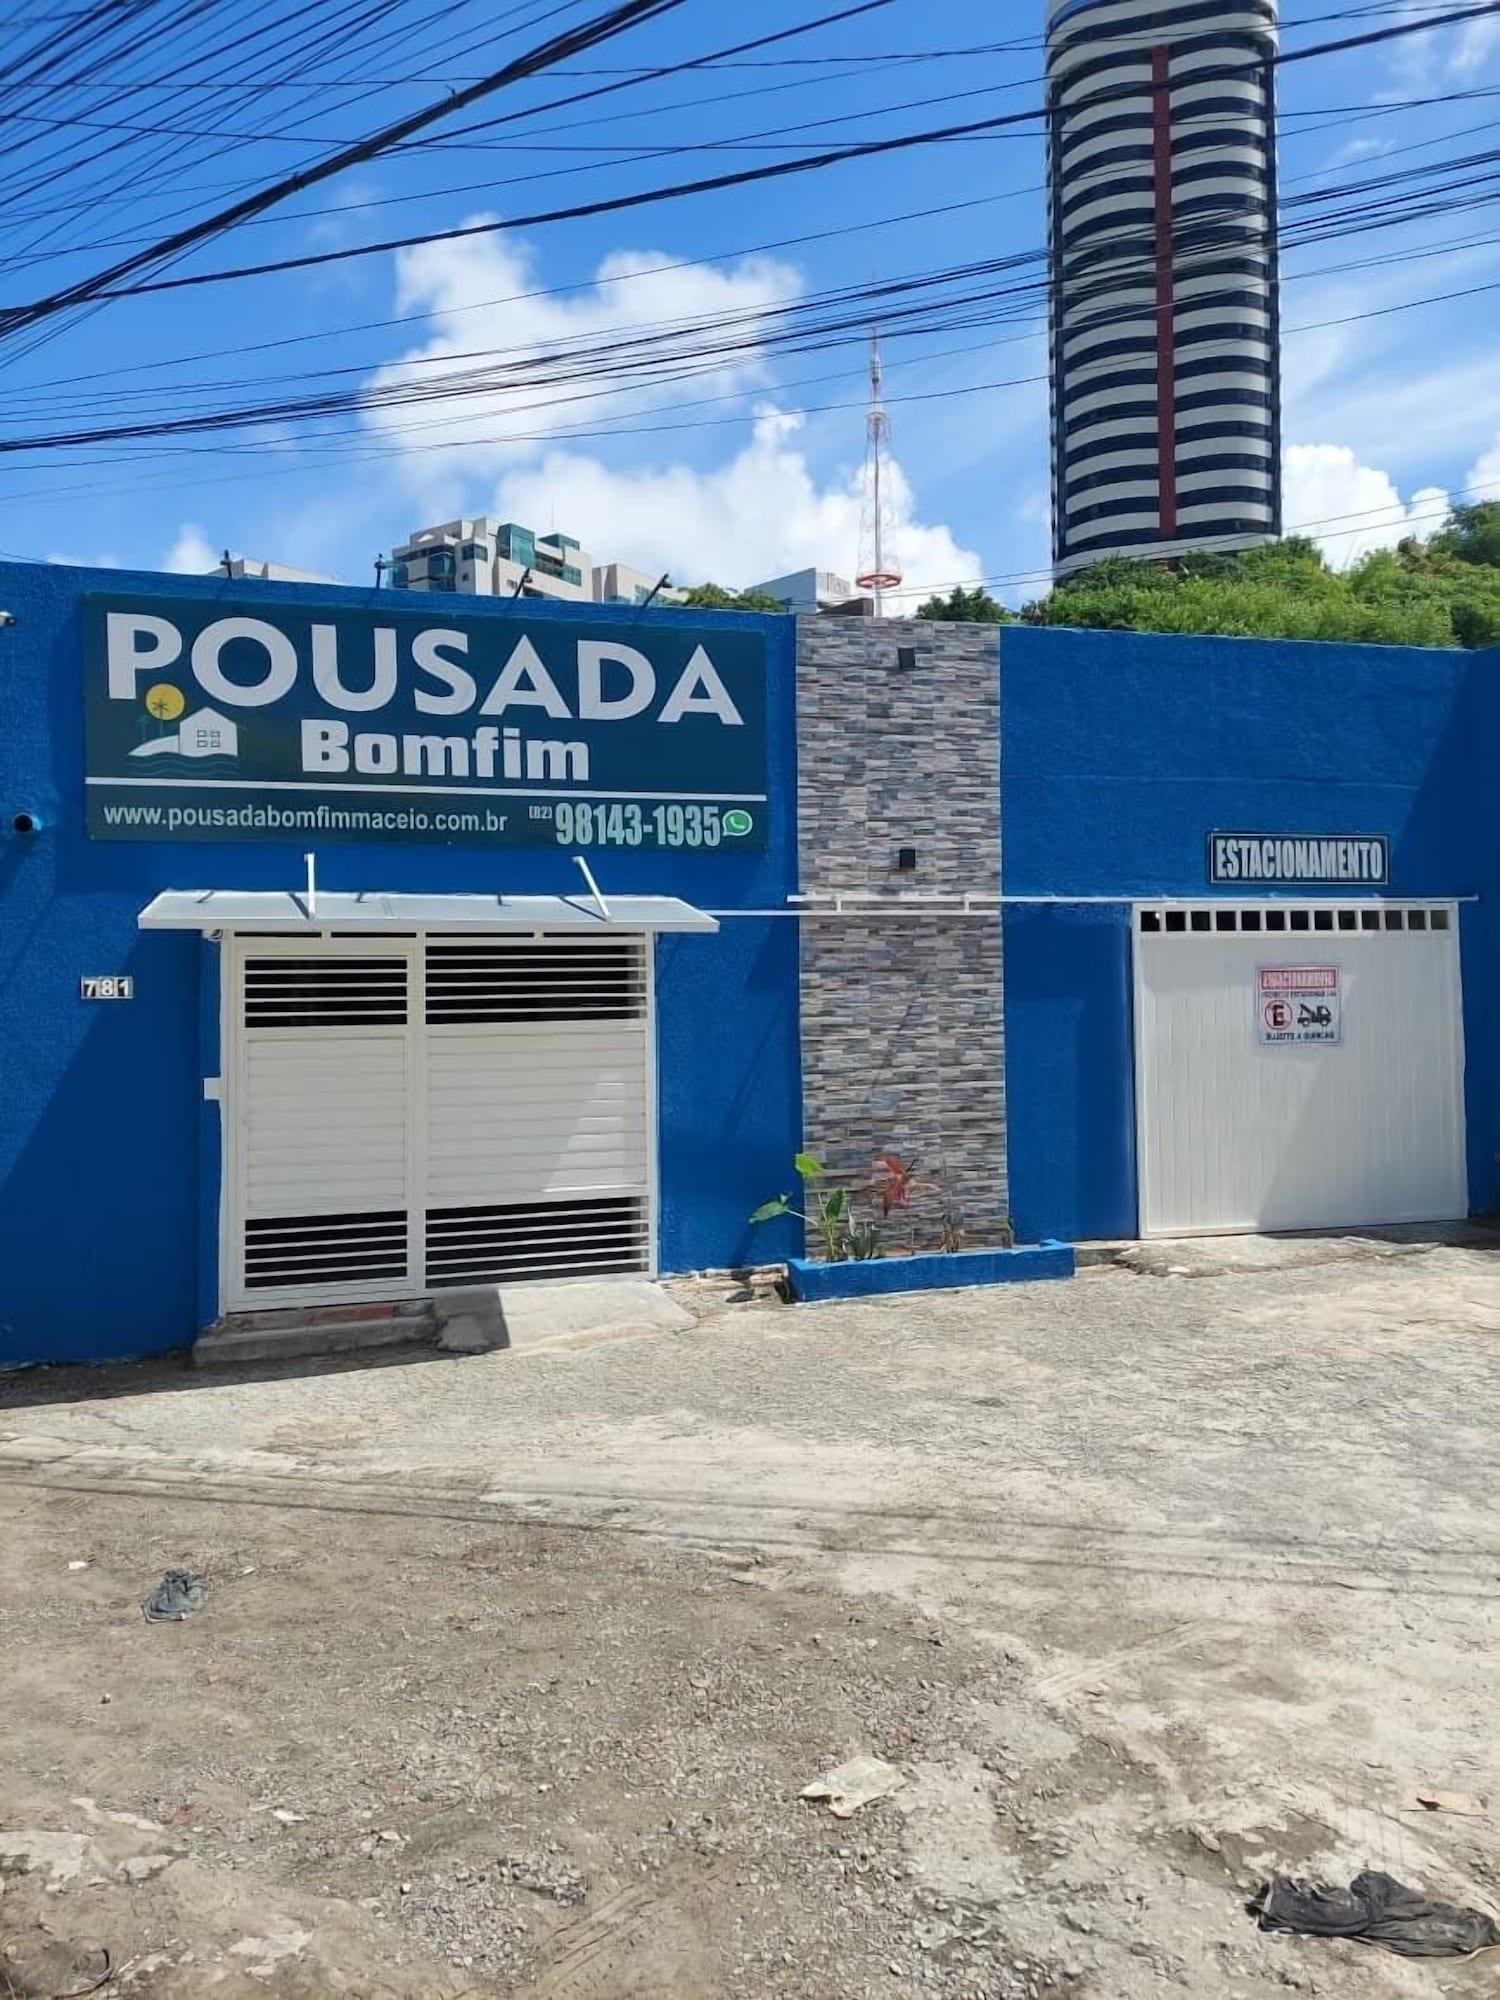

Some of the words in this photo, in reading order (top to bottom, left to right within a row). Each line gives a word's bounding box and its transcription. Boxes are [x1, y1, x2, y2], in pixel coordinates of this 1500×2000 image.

[106, 612, 745, 726] POUSADA
[301, 719, 590, 782] Bomfim
[103, 804, 508, 832] www.pousadabomfimmaceio.com.br
[555, 802, 721, 847] 98143-1935
[1215, 839, 1383, 879] ESTACIONAMENTO
[83, 979, 129, 998] 781
